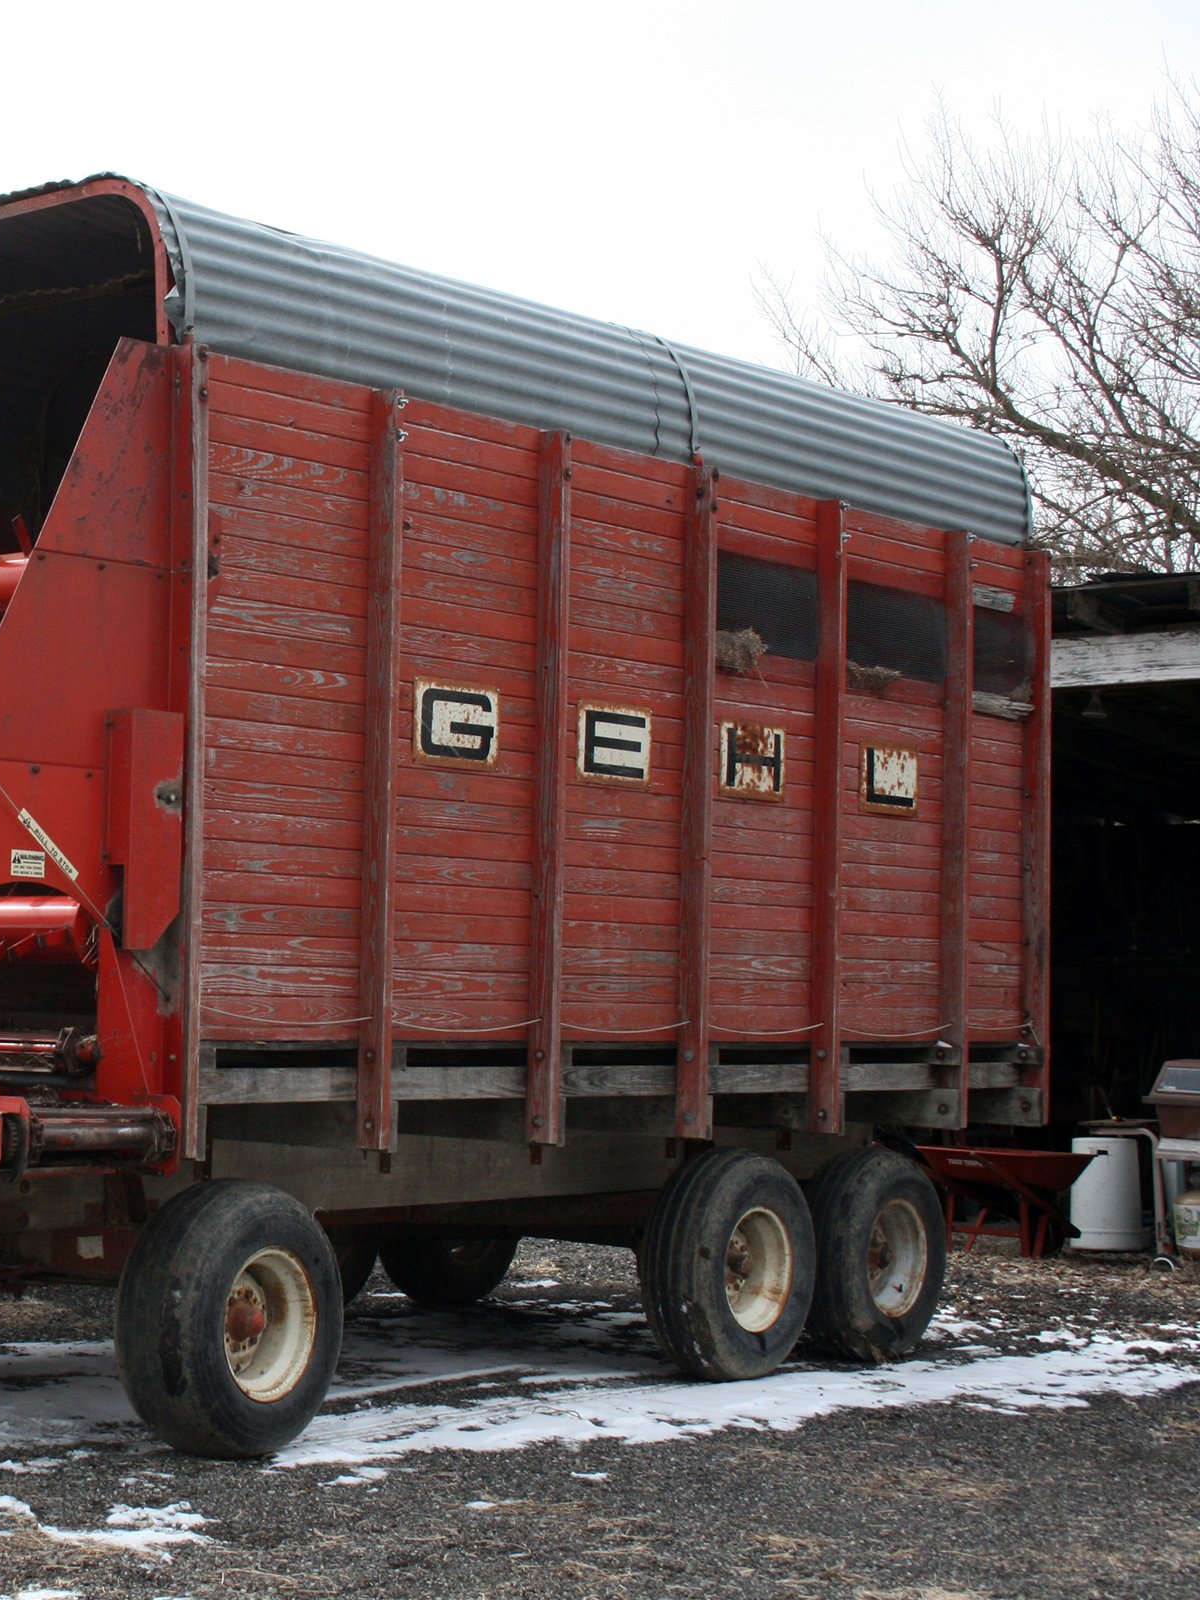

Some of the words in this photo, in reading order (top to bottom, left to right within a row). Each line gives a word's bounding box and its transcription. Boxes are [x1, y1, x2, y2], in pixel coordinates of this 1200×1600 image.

[20, 853, 45, 861] WARNING
[33, 828, 48, 848] PULL
[50, 847, 59, 857] TO
[58, 857, 73, 874] STOP
